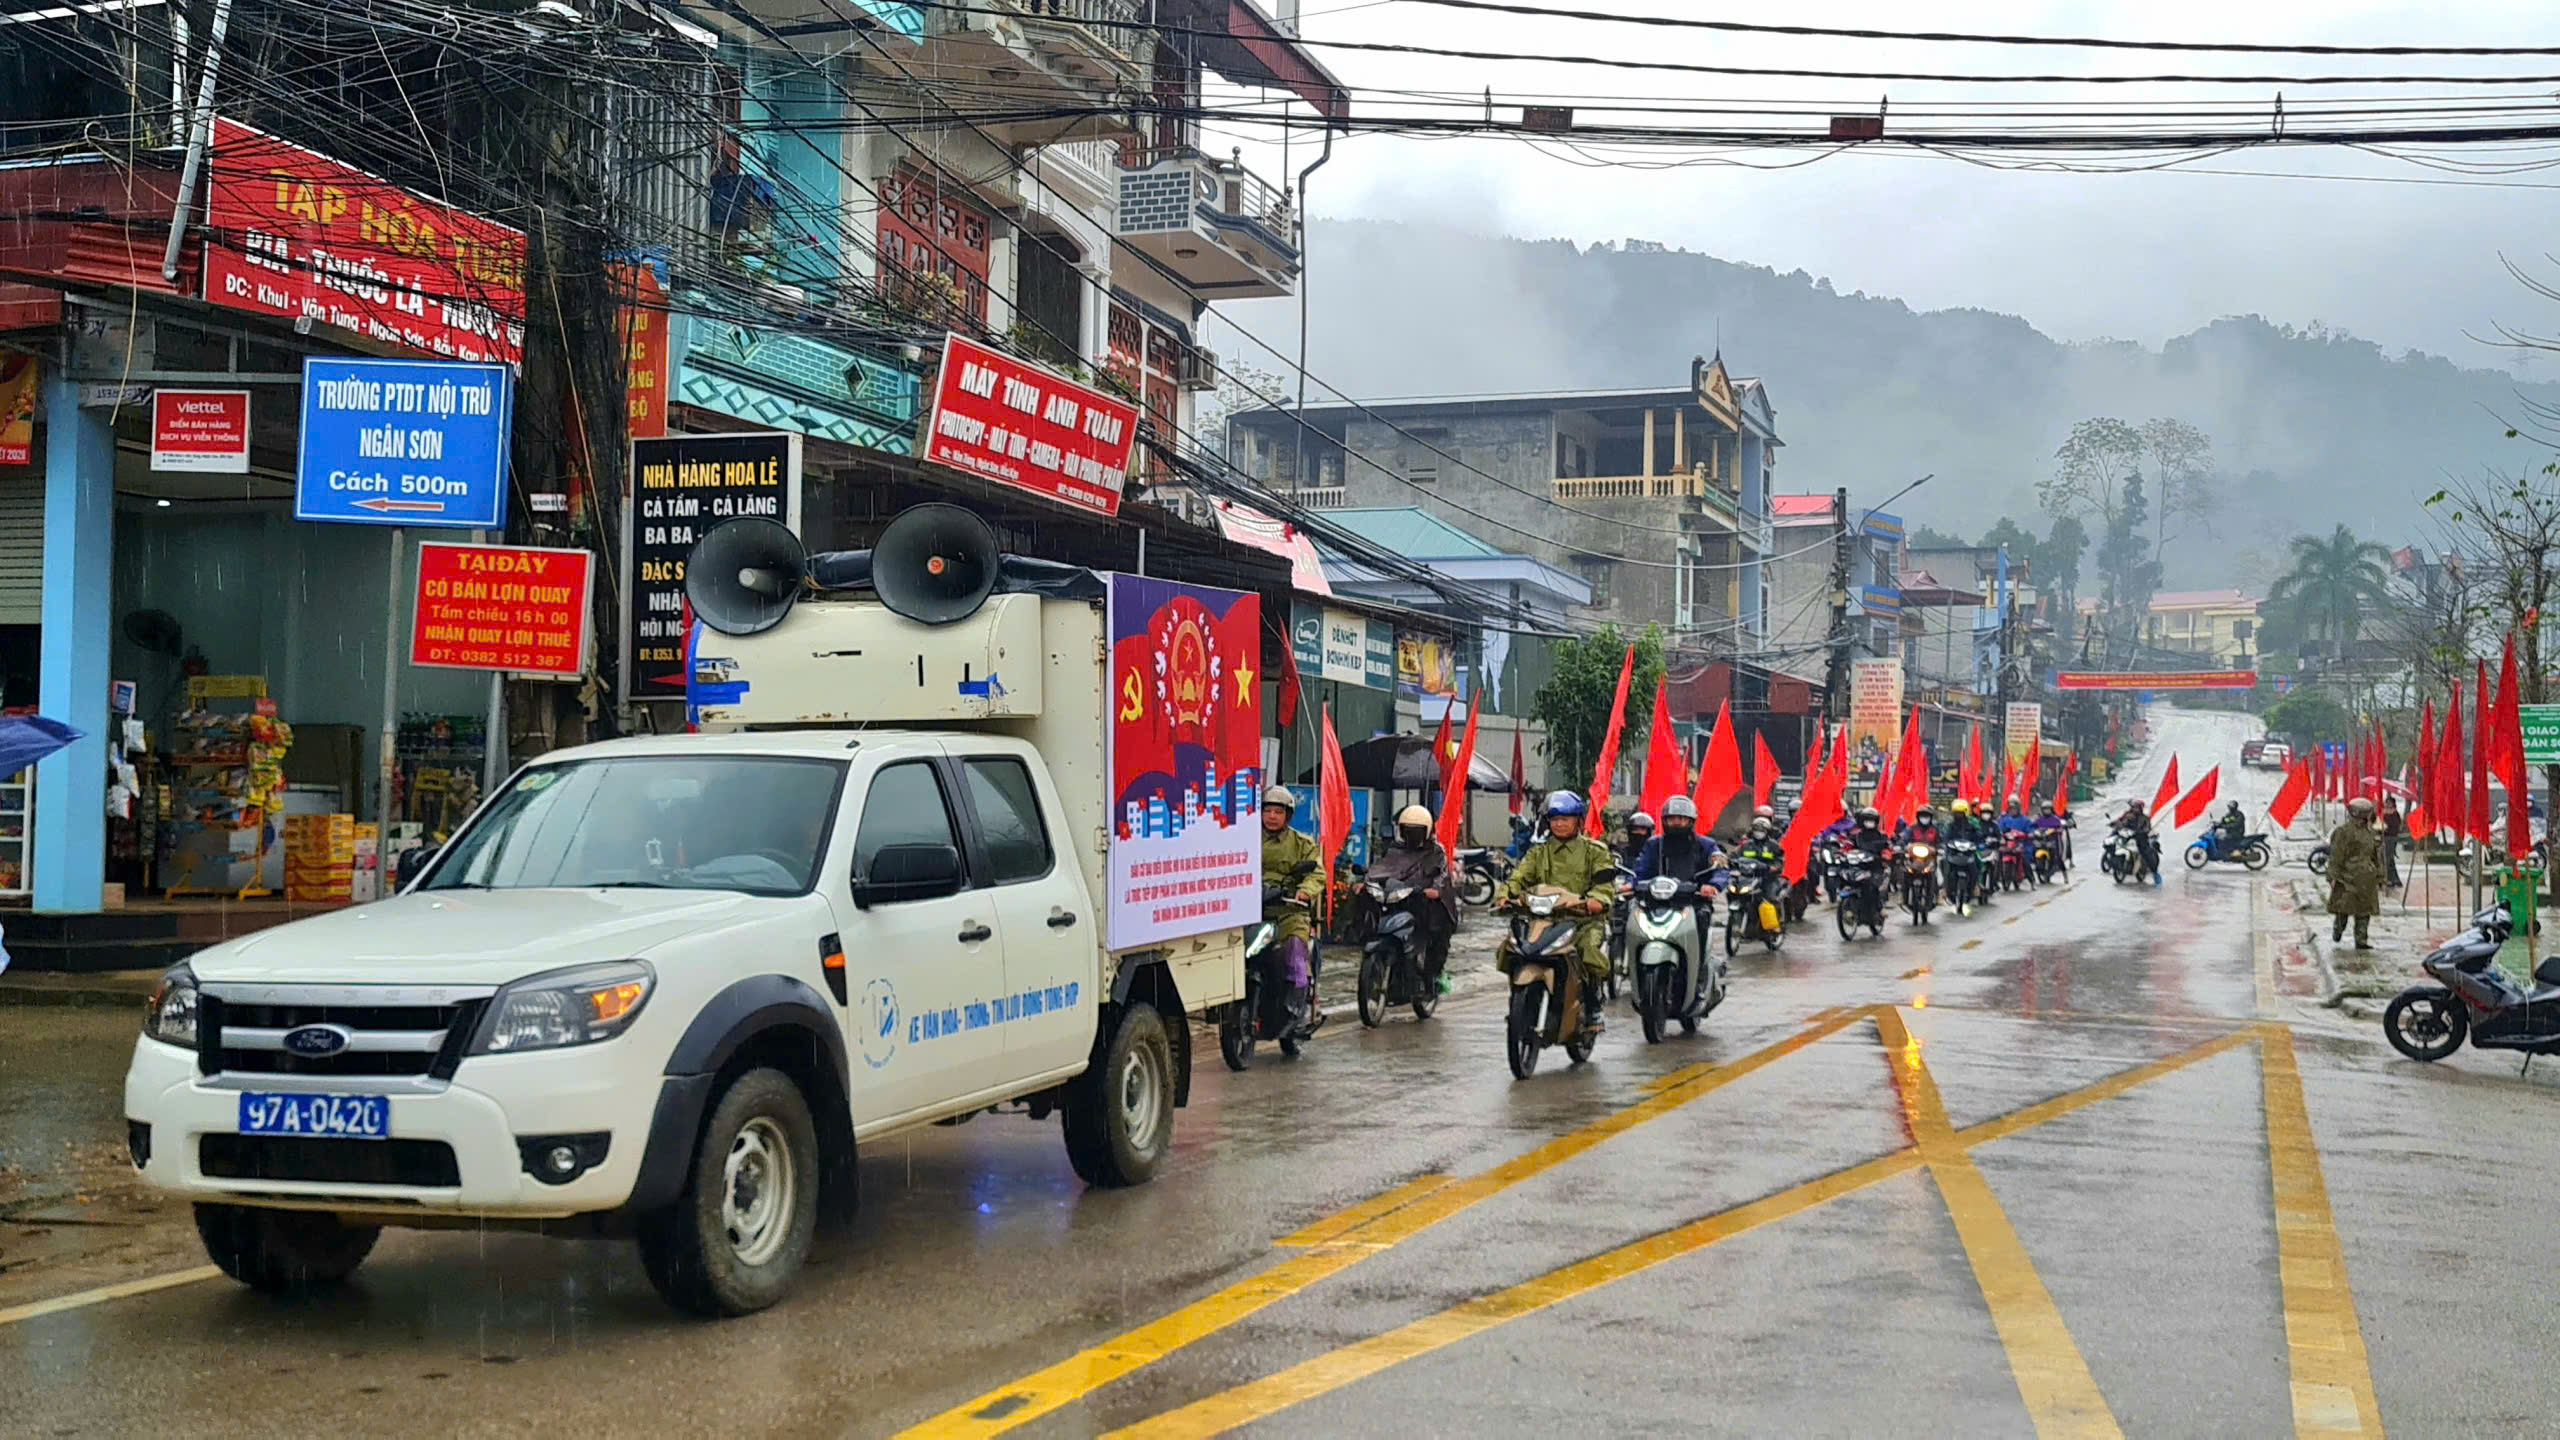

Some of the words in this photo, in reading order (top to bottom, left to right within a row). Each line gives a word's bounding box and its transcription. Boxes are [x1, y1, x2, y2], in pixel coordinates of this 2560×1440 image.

[225, 273, 252, 298] ĐC:
[301, 297, 326, 321] Vân
[330, 305, 359, 332] Tùng
[177, 400, 226, 414] viettel
[318, 374, 380, 411] TRƯỜNG
[384, 383, 425, 413] PTDT
[428, 378, 456, 419] NỘI
[461, 380, 491, 415] TRÚ
[960, 361, 998, 399] MÁY
[1003, 375, 1040, 415] TÍNH
[1043, 393, 1079, 430] ANH
[938, 409, 985, 446] PHOTOCOPY
[359, 423, 405, 458] NGÂN
[409, 429, 443, 460] SƠN
[329, 471, 389, 492] Cách
[401, 475, 468, 496] 500m
[643, 459, 674, 489] NHÀ
[679, 458, 721, 487] HÀNG
[725, 461, 755, 486] HOA
[760, 456, 778, 486] LÊ
[737, 493, 777, 515] LĂNG
[645, 527, 666, 545] BA
[671, 526, 693, 544] BA
[642, 557, 672, 584] ĐẶC
[425, 577, 448, 598] CÓ
[452, 578, 487, 600] BÁN
[492, 582, 525, 605] LỢN
[530, 585, 571, 604] QUAY
[551, 612, 568, 625] 00
[640, 620, 662, 640] HỘI
[666, 621, 685, 637] NG
[425, 623, 464, 643] NHẬN
[468, 626, 503, 644] QUAY
[505, 628, 533, 648] LỢN
[430, 648, 456, 661] ĐT:
[460, 651, 497, 663] 0382
[503, 653, 531, 666] 512
[536, 654, 563, 667] 387
[249, 1096, 380, 1134] 97A-0420
